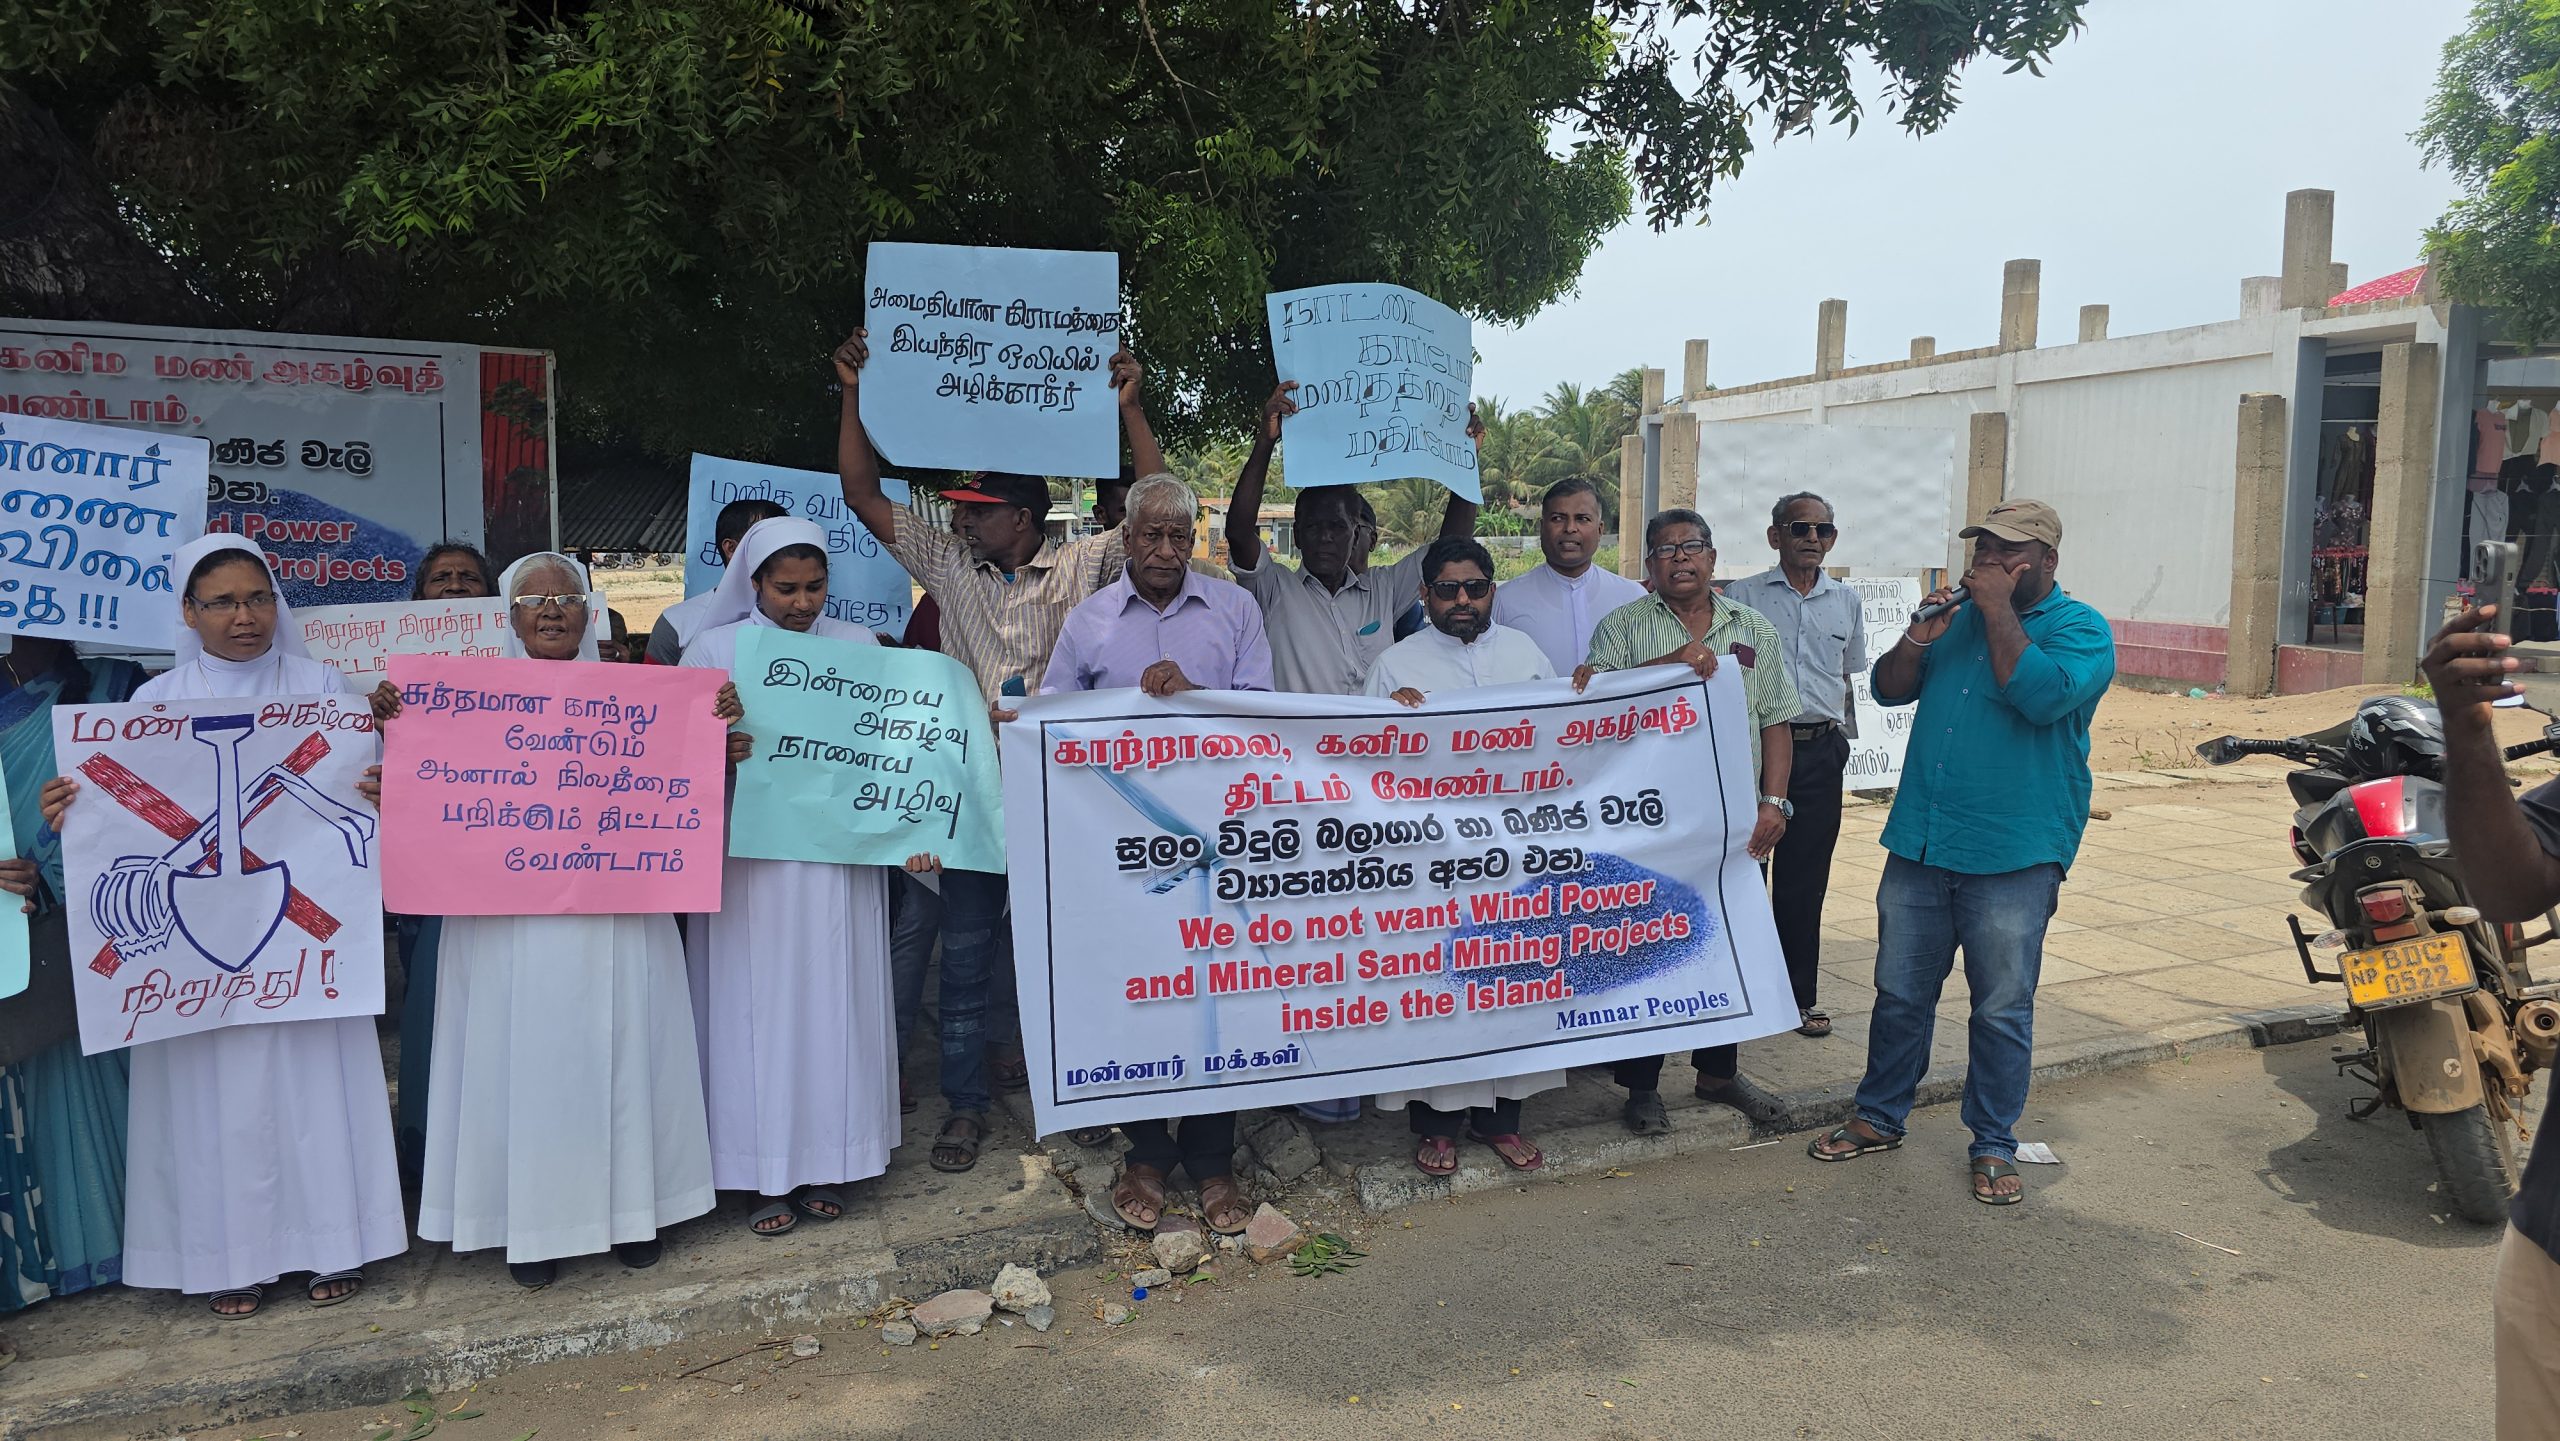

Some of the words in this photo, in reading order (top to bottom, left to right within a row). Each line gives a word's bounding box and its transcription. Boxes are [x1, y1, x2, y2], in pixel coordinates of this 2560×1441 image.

[870, 287, 1001, 322] அமைதியான
[1005, 299, 1119, 337] கிராமத்தை
[1283, 293, 1434, 343] நாட்டை
[0, 342, 127, 374] கனிம
[155, 352, 254, 379] மண்
[263, 357, 444, 392] அகழ்வுத்
[890, 324, 993, 368] இயந்திர
[998, 344, 1099, 371] ஒலியில்
[936, 373, 1082, 412] அழிக்காதீர்
[301, 440, 372, 473] වැලි
[243, 513, 356, 542] Power
[304, 613, 386, 651] நிறுத்து
[396, 607, 482, 647] நிறுத்து
[763, 658, 943, 713] இன்றைய
[72, 704, 189, 743] மண்
[401, 681, 551, 718] சுத்தமான
[564, 696, 657, 735] காற்று
[505, 725, 645, 758] வேண்டும்
[769, 735, 913, 773] நாளைய
[854, 712, 968, 764] அகழ்வு
[1054, 730, 1291, 771] காற்றாலை,
[1316, 724, 1429, 756] கனிம
[1451, 719, 1536, 752] மண்
[1557, 696, 1698, 746] அகழ்வுத்
[417, 759, 537, 786] ஆனால்
[558, 760, 690, 803] நிலத்தை
[1224, 773, 1351, 816] திட்டம்
[1371, 761, 1573, 800] வேண்டாம்.
[442, 798, 581, 831] பறிக்கும்
[599, 806, 701, 836] திட்டம்
[854, 780, 962, 839] அழிவு
[1115, 835, 1201, 871] සුලං
[1218, 818, 1301, 863] විදුලි
[1316, 813, 1445, 854] බලාගාර
[1455, 816, 1493, 839] හා
[1600, 789, 1664, 827] වැලි
[505, 843, 684, 872] வேண்டாம்
[1429, 848, 1510, 889] අපට
[1523, 845, 1594, 874] එපා.
[1178, 916, 1235, 949] We
[1248, 913, 1292, 943] do
[1306, 906, 1363, 939] not
[1375, 897, 1459, 934] want
[1470, 887, 1550, 923] Wind
[1561, 880, 1655, 913] Power
[1125, 966, 1194, 1001] and
[1208, 952, 1344, 993] Mineral
[1357, 943, 1442, 980] Sand
[1454, 932, 1560, 969] Mining
[1571, 911, 1689, 954] Projects
[2351, 968, 2377, 987] NP
[2384, 942, 2443, 970] BDC
[2384, 964, 2451, 994] 0522
[1282, 995, 1388, 1032] inside
[1400, 989, 1454, 1020] the
[1467, 972, 1572, 1011] Island.
[1556, 1003, 1640, 1031] Mannar
[1646, 990, 1730, 1018] Peoples
[1067, 1054, 1186, 1087] மன்னார்
[1204, 1043, 1300, 1073] மக்கள்
